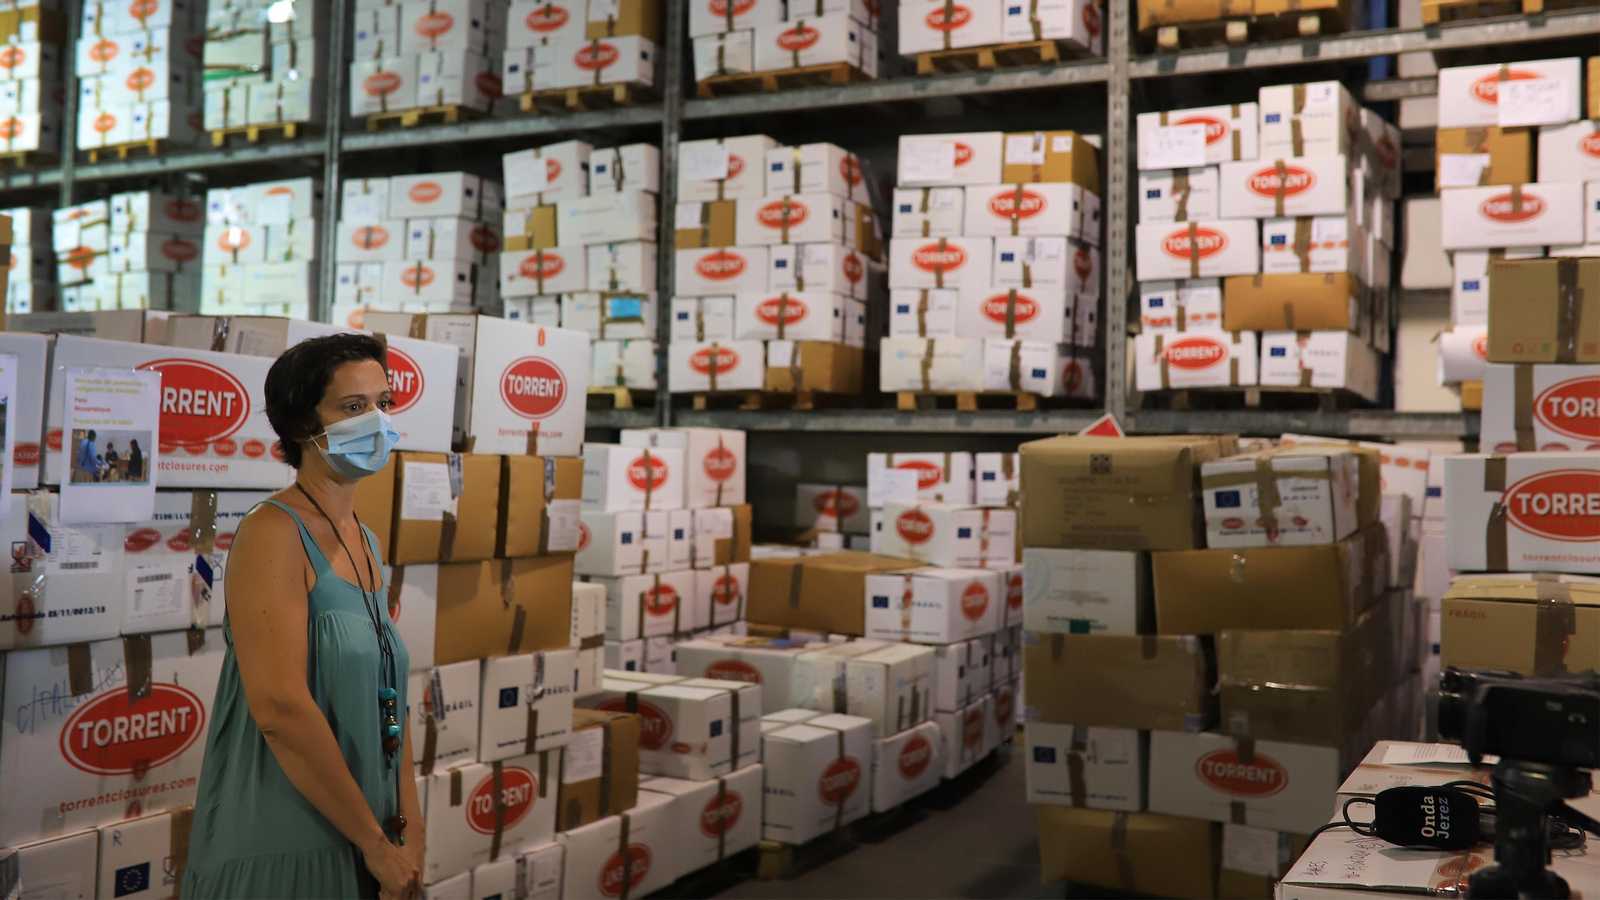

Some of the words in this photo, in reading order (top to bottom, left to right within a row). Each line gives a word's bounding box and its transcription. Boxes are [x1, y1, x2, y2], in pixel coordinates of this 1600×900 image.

[1253, 173, 1309, 189] TORENT
[992, 198, 1042, 211] TORENT
[1167, 235, 1222, 251] TORENT
[987, 302, 1035, 315] TORENT
[387, 369, 414, 393] ENT
[508, 374, 561, 399] TORRENT
[162, 386, 236, 418] RRENT
[1516, 493, 1600, 515] TORRE
[1449, 609, 1487, 620] FRÁGIL
[445, 700, 473, 712] RÁGIL
[78, 705, 192, 750] TORRENT
[1205, 760, 1279, 784] TORRENT
[60, 775, 196, 814] torrentclosures.com
[1421, 795, 1436, 838] Onda
[1437, 796, 1450, 839] Jerez
